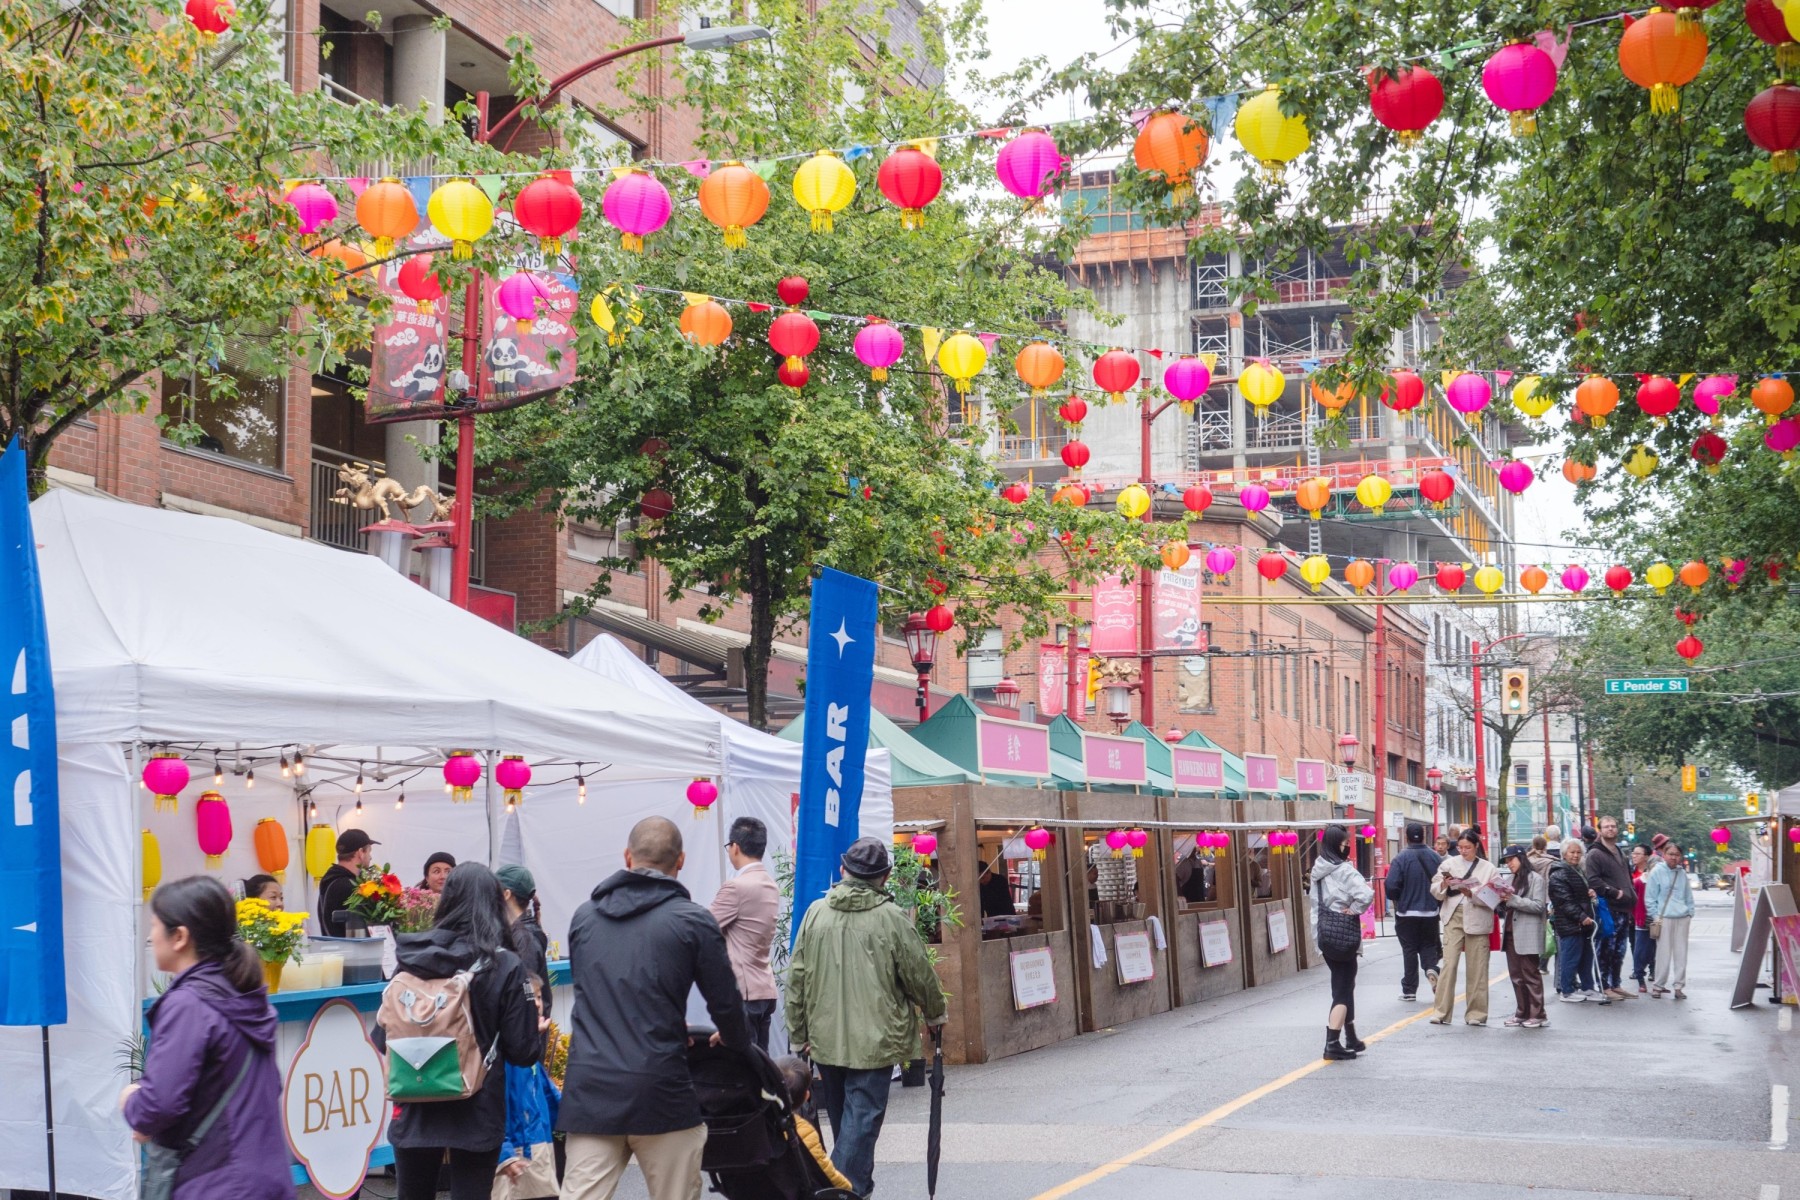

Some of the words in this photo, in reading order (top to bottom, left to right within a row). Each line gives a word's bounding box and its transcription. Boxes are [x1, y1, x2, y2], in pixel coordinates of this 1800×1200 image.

[1611, 681, 1619, 691] E
[1623, 681, 1664, 691] Pender
[1669, 680, 1682, 690] St
[824, 701, 849, 828] BAR
[1178, 760, 1203, 777] HAWKERS
[1204, 762, 1218, 778] LANE
[1341, 776, 1360, 784] BEGIN
[303, 1067, 372, 1134] BAR
